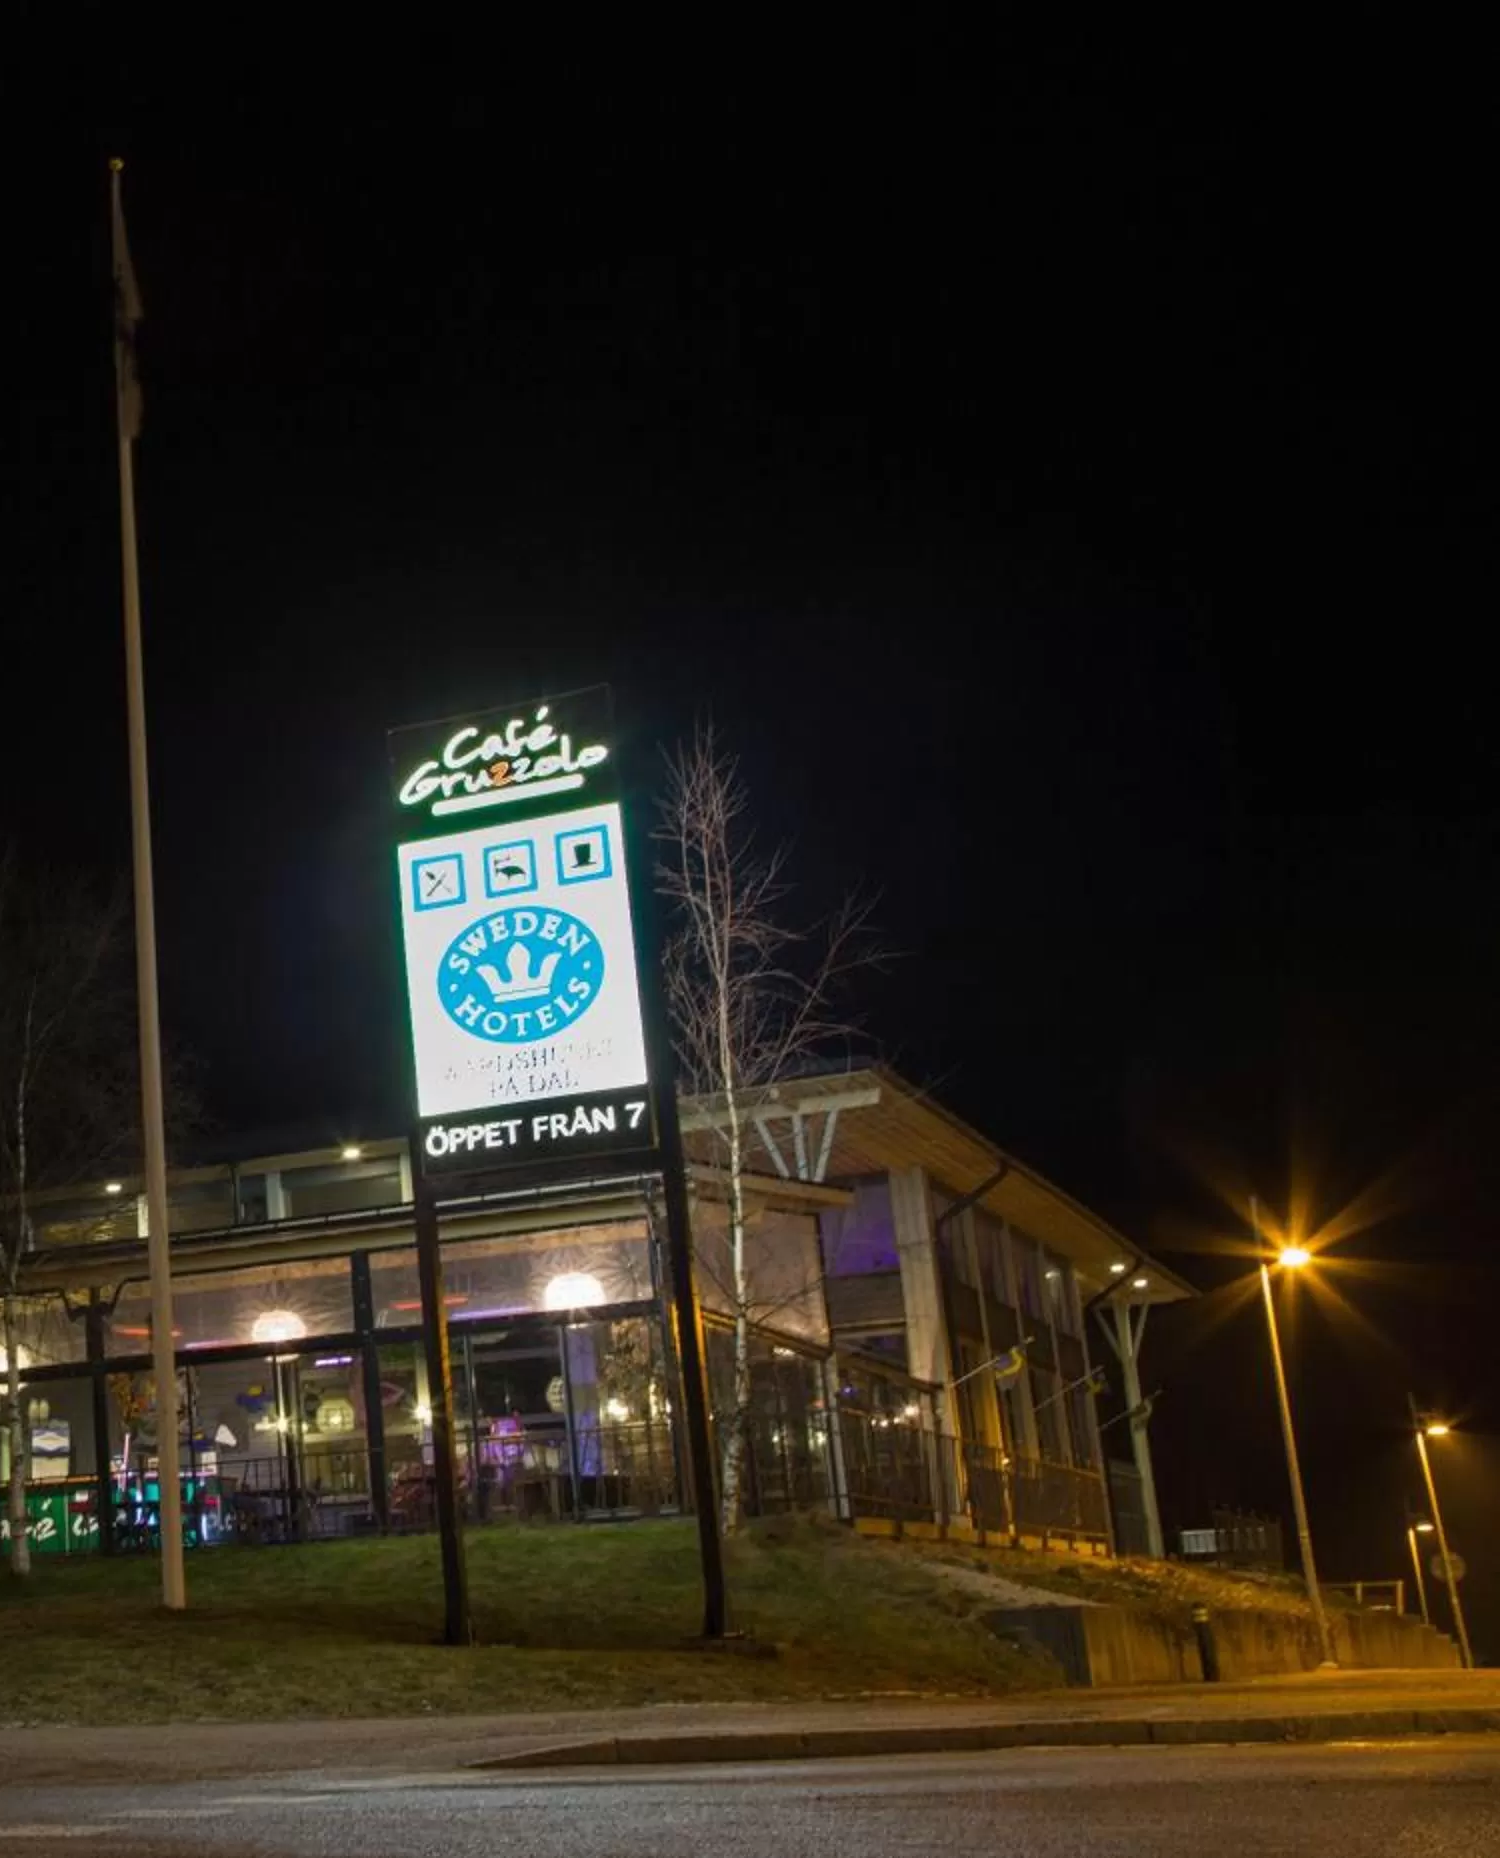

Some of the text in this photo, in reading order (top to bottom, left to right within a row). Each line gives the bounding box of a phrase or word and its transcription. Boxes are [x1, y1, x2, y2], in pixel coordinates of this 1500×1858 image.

[444, 706, 556, 766] Café
[400, 735, 609, 804] Gruzzolo
[449, 911, 591, 974] SWEDEN
[454, 976, 592, 1039] HOTELS
[426, 1101, 648, 1156] ÖPPET FRÅN 7
